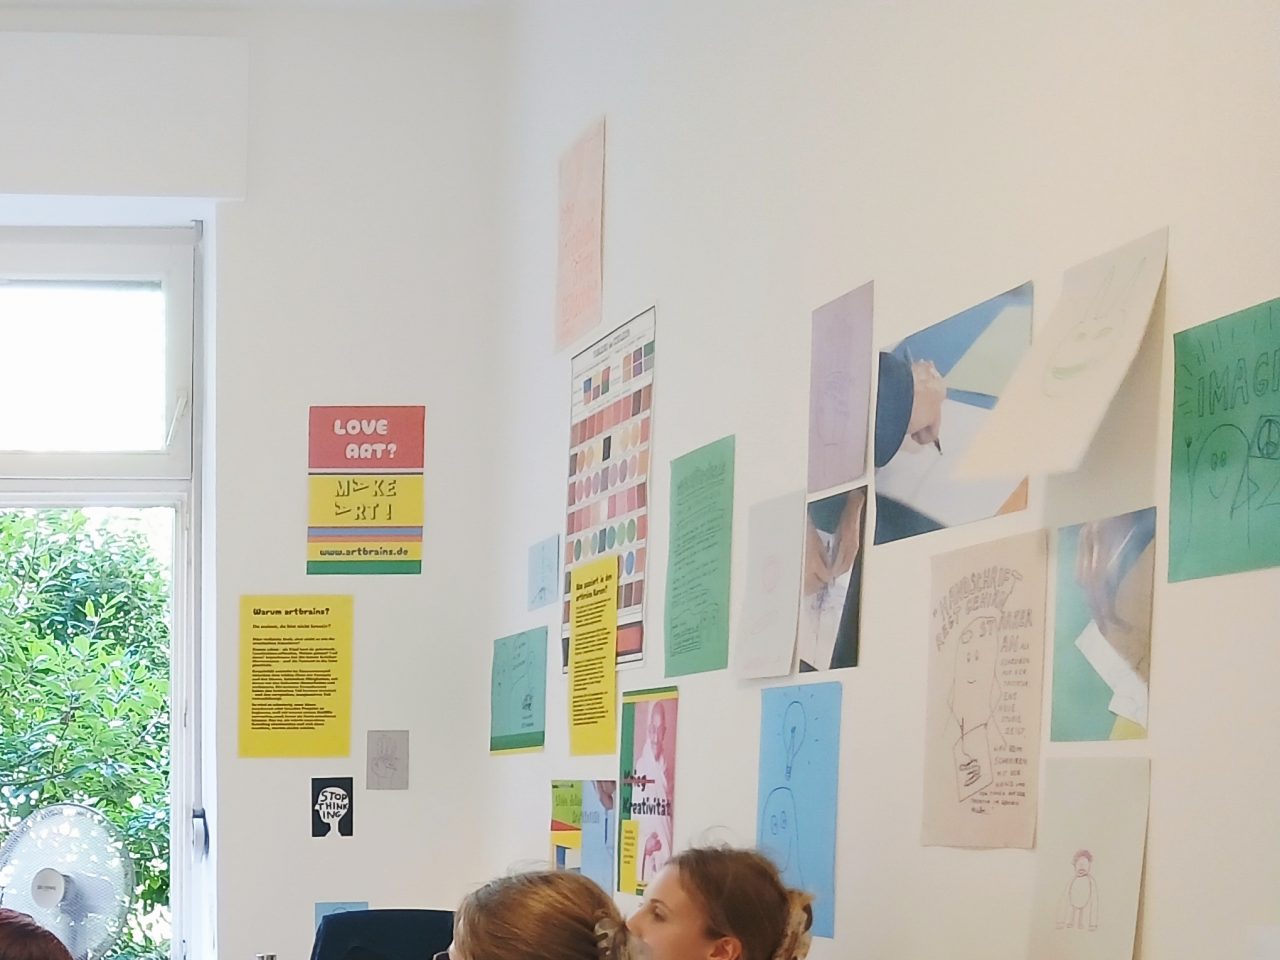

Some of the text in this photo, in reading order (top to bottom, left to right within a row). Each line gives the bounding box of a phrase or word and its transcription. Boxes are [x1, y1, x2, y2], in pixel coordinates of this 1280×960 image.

[333, 419, 388, 436] LOVE
[345, 442, 397, 459] ART?
[334, 478, 397, 497] MAKE
[319, 546, 409, 556] www.artbrains.de
[252, 607, 330, 616] Warum artbrains?
[320, 790, 348, 802] STOP
[622, 797, 671, 817] Kreativität
